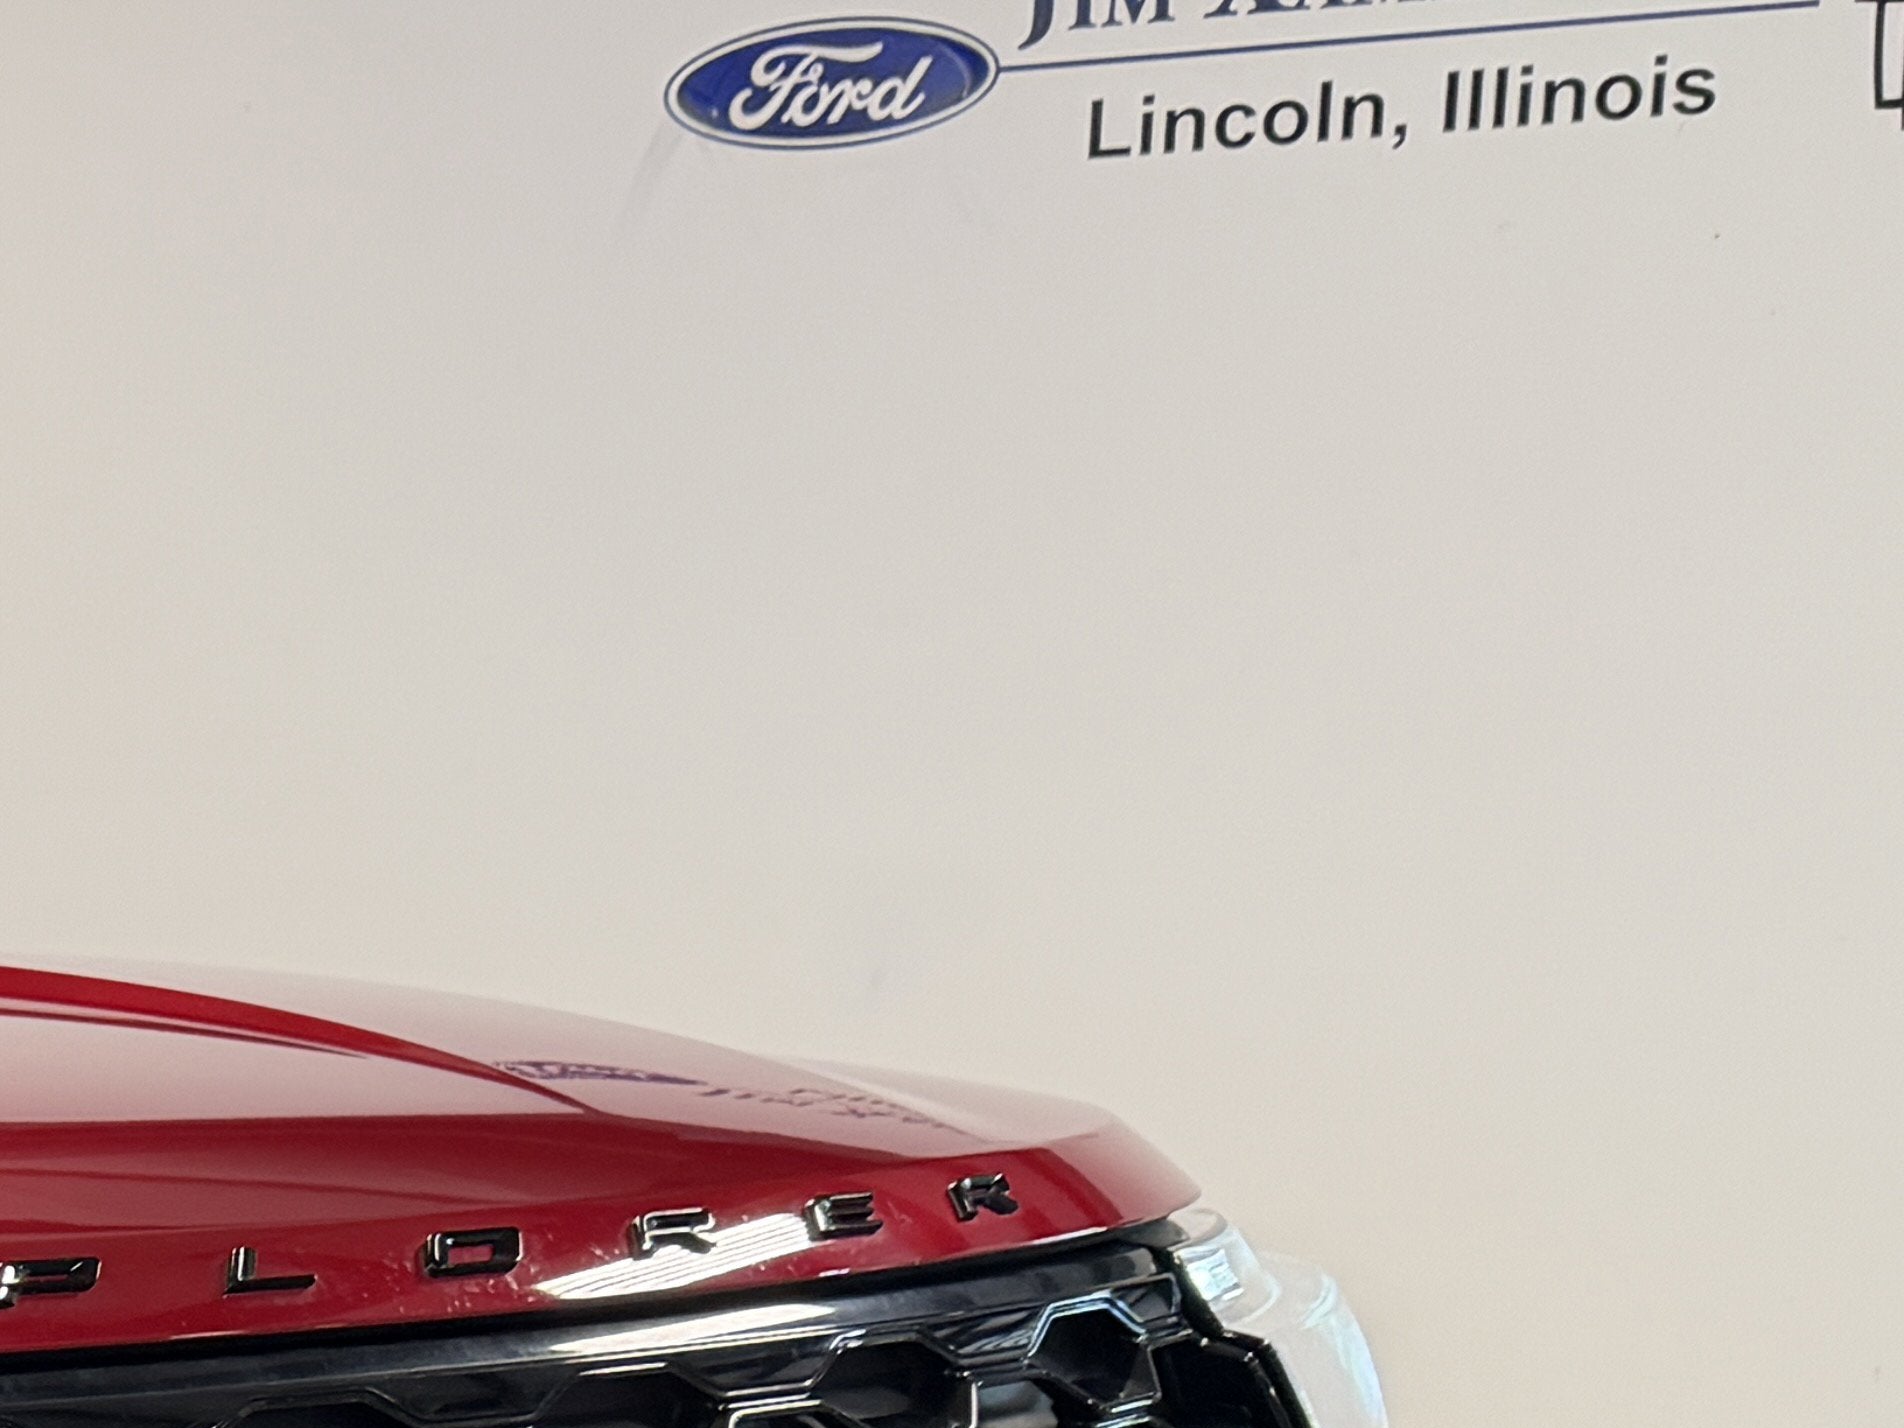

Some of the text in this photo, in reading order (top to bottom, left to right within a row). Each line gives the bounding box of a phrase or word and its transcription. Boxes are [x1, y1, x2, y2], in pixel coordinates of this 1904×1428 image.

[728, 42, 925, 131] Ford
[1087, 54, 1717, 160] Lincoln, Illinois
